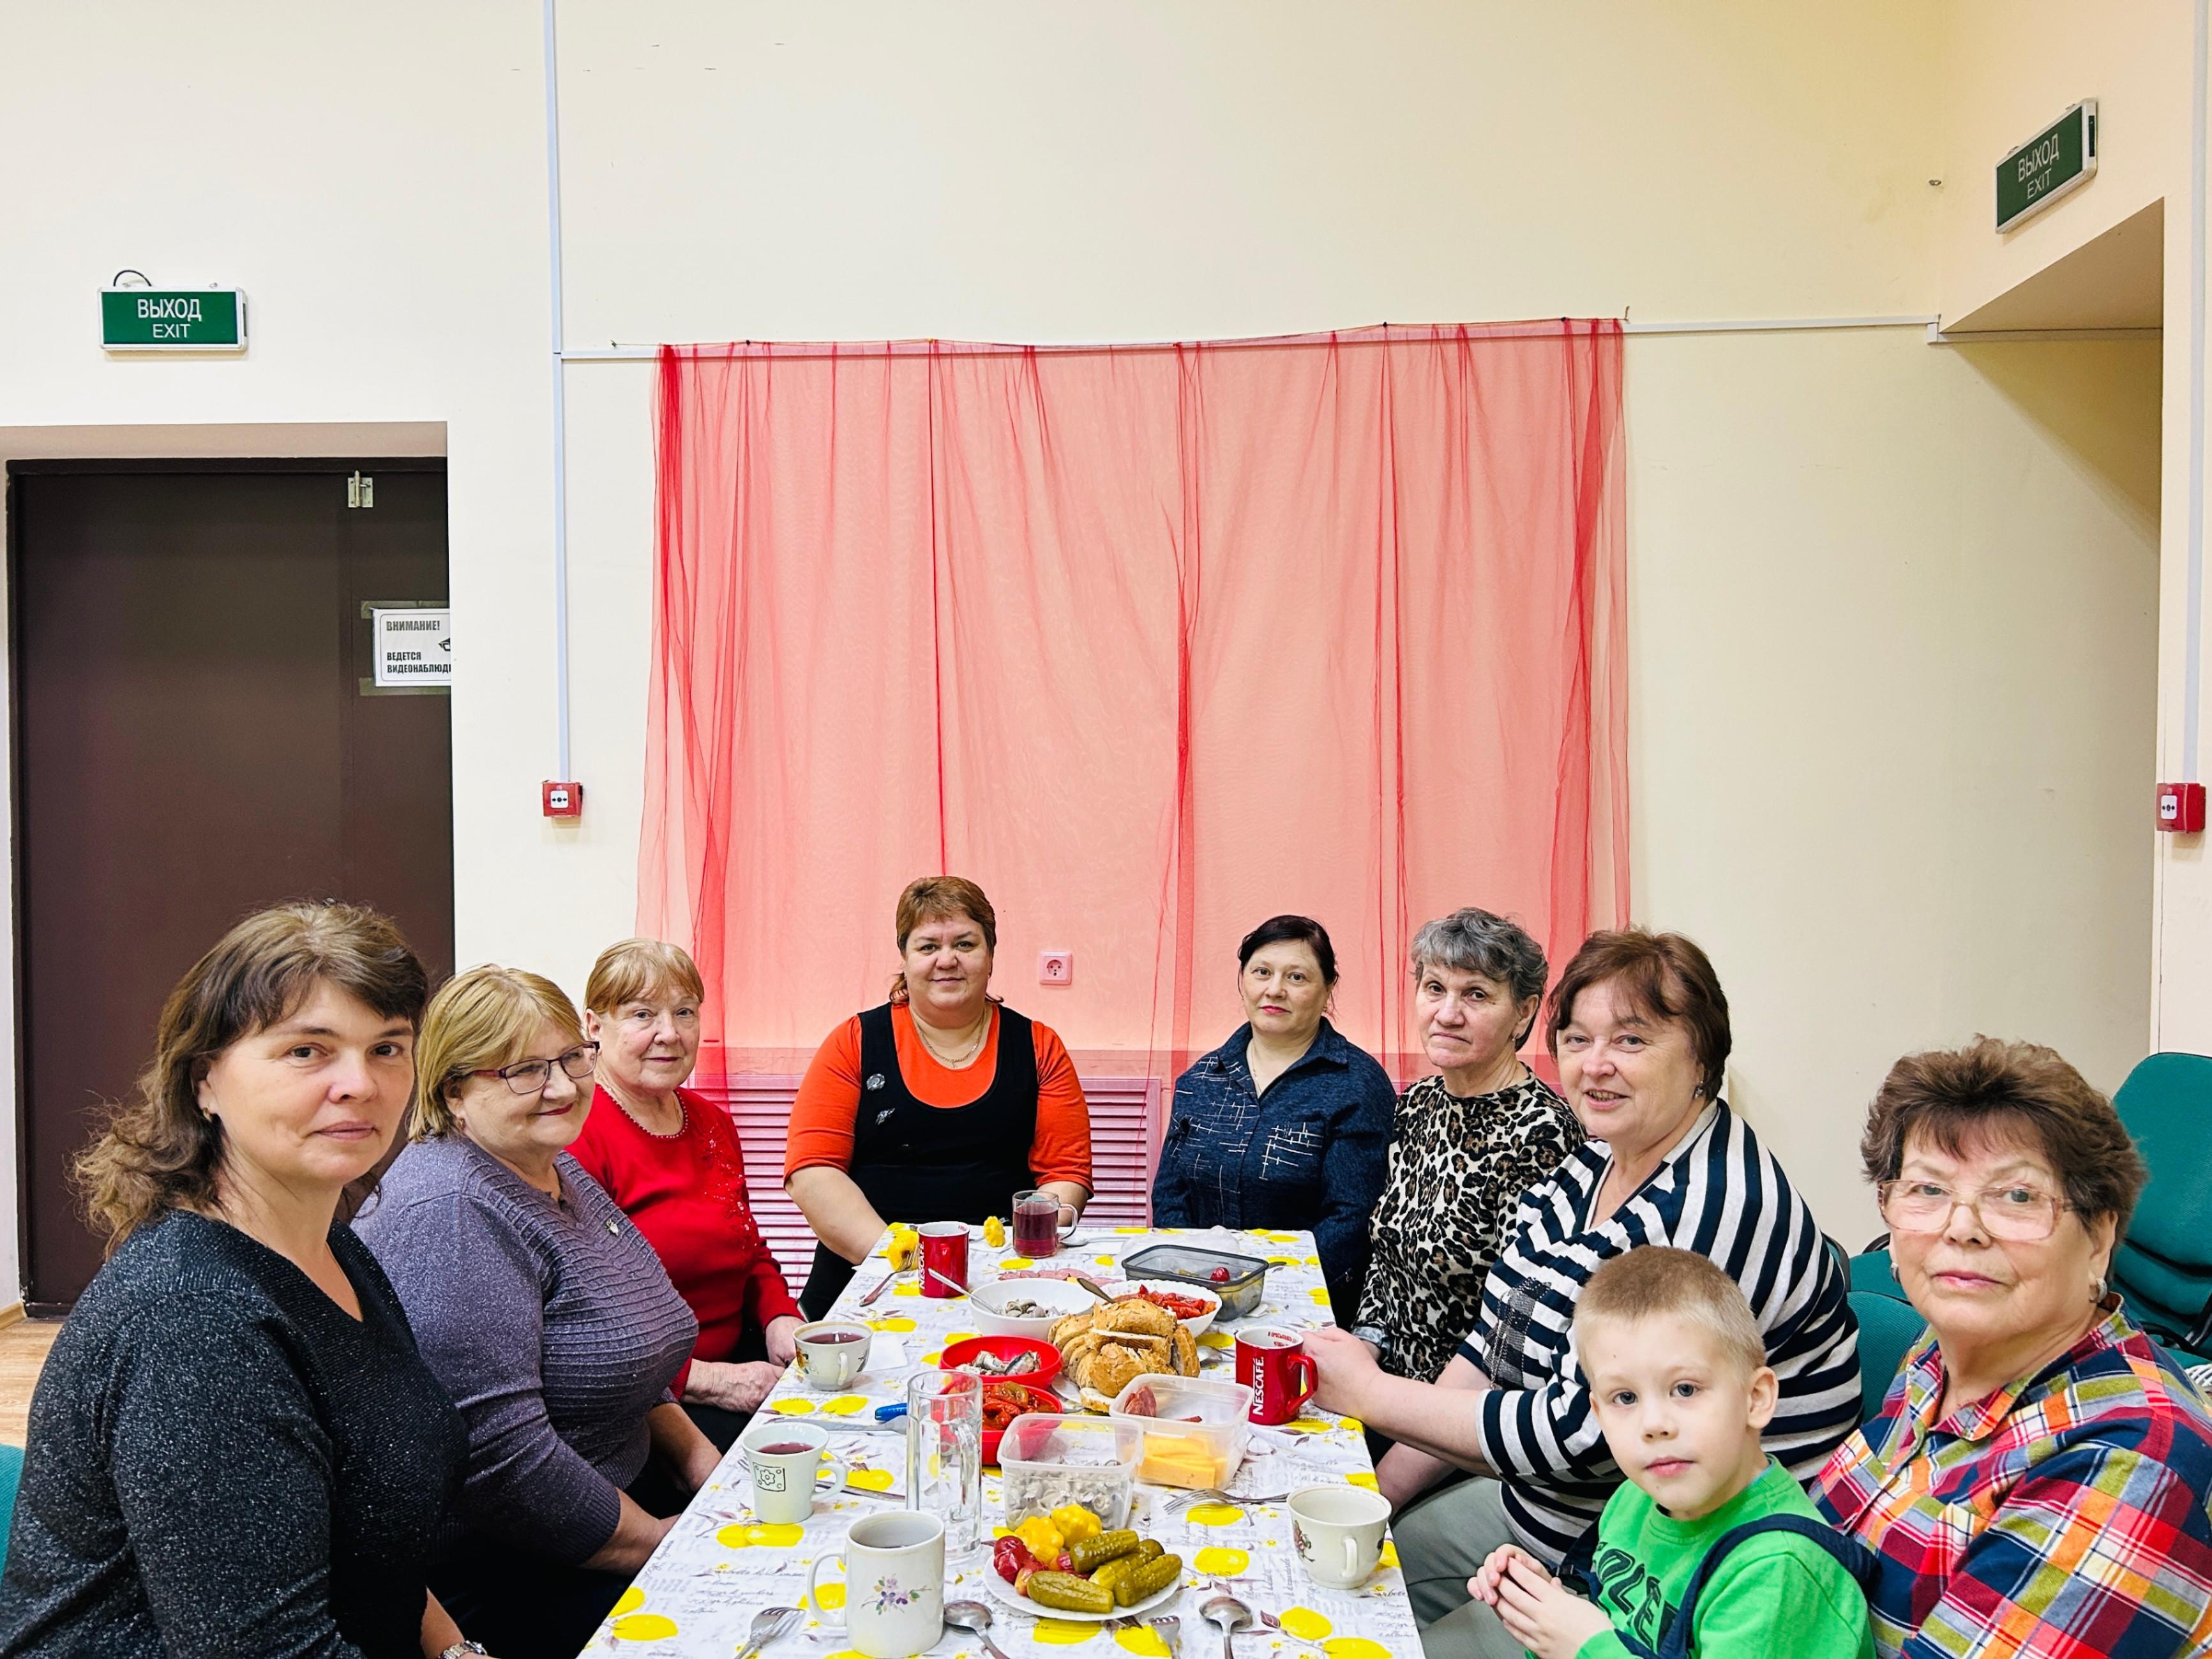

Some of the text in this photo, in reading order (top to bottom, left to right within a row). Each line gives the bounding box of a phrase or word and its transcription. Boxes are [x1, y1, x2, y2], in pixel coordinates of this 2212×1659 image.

[2018, 133, 2059, 183] ВЫХОД
[2027, 168, 2052, 200] EXIT
[137, 298, 202, 322] ВЫХОД
[153, 324, 191, 338] EXIT
[386, 620, 440, 631] ВНИМАНИЕ!
[386, 652, 421, 661] ВЕДЕТСЯ
